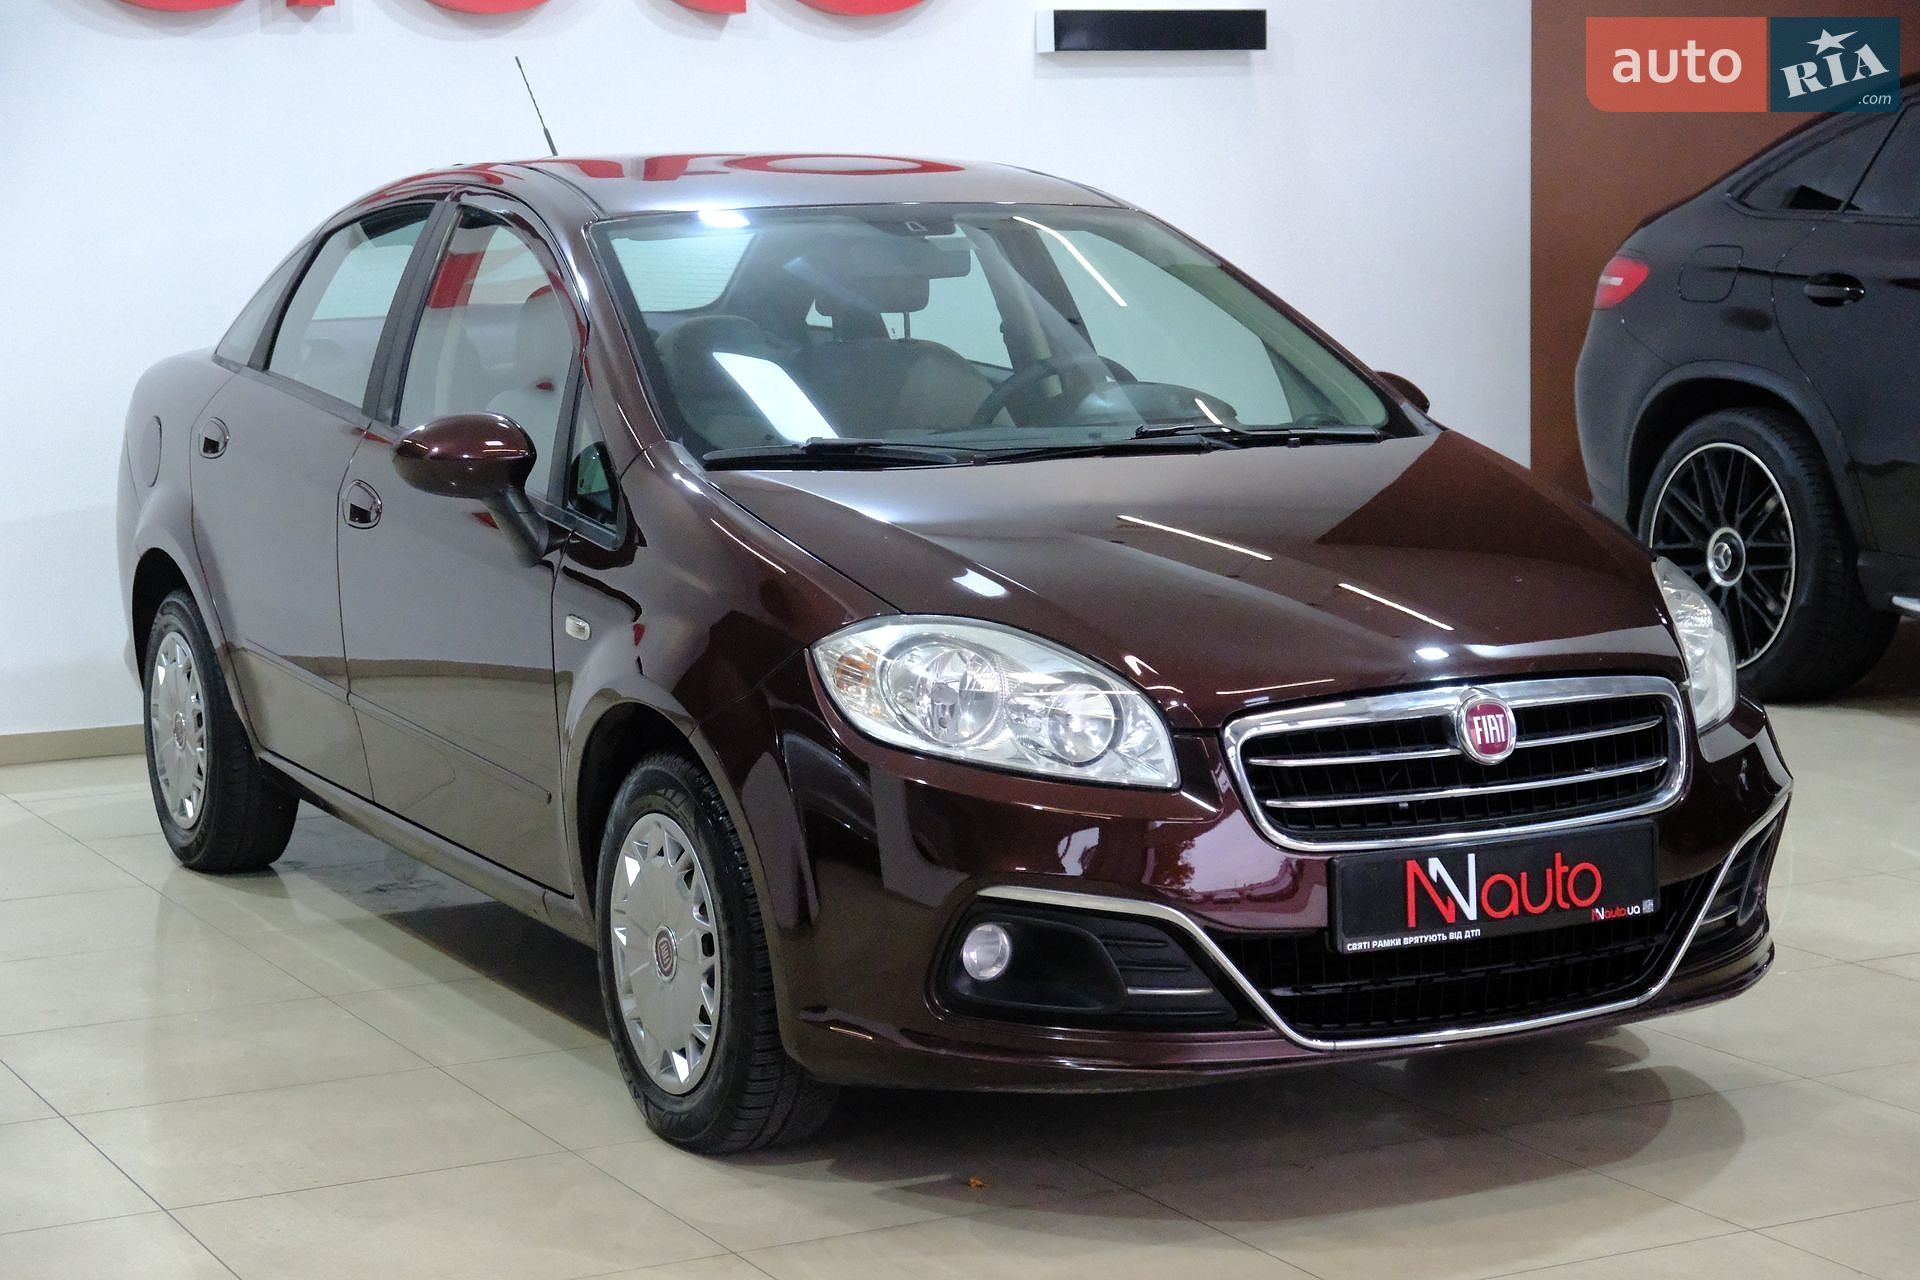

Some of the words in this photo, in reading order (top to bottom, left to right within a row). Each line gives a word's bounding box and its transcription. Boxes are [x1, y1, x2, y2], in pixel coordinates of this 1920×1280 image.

[1473, 714, 1505, 745] FIAT
[1346, 941, 1371, 952] СВЯТІ
[1372, 938, 1402, 949] РАМКИ
[1403, 934, 1448, 946] ВРЯТУЮТЬ
[1449, 931, 1464, 941] ВІД
[1464, 928, 1481, 940] ДТП
